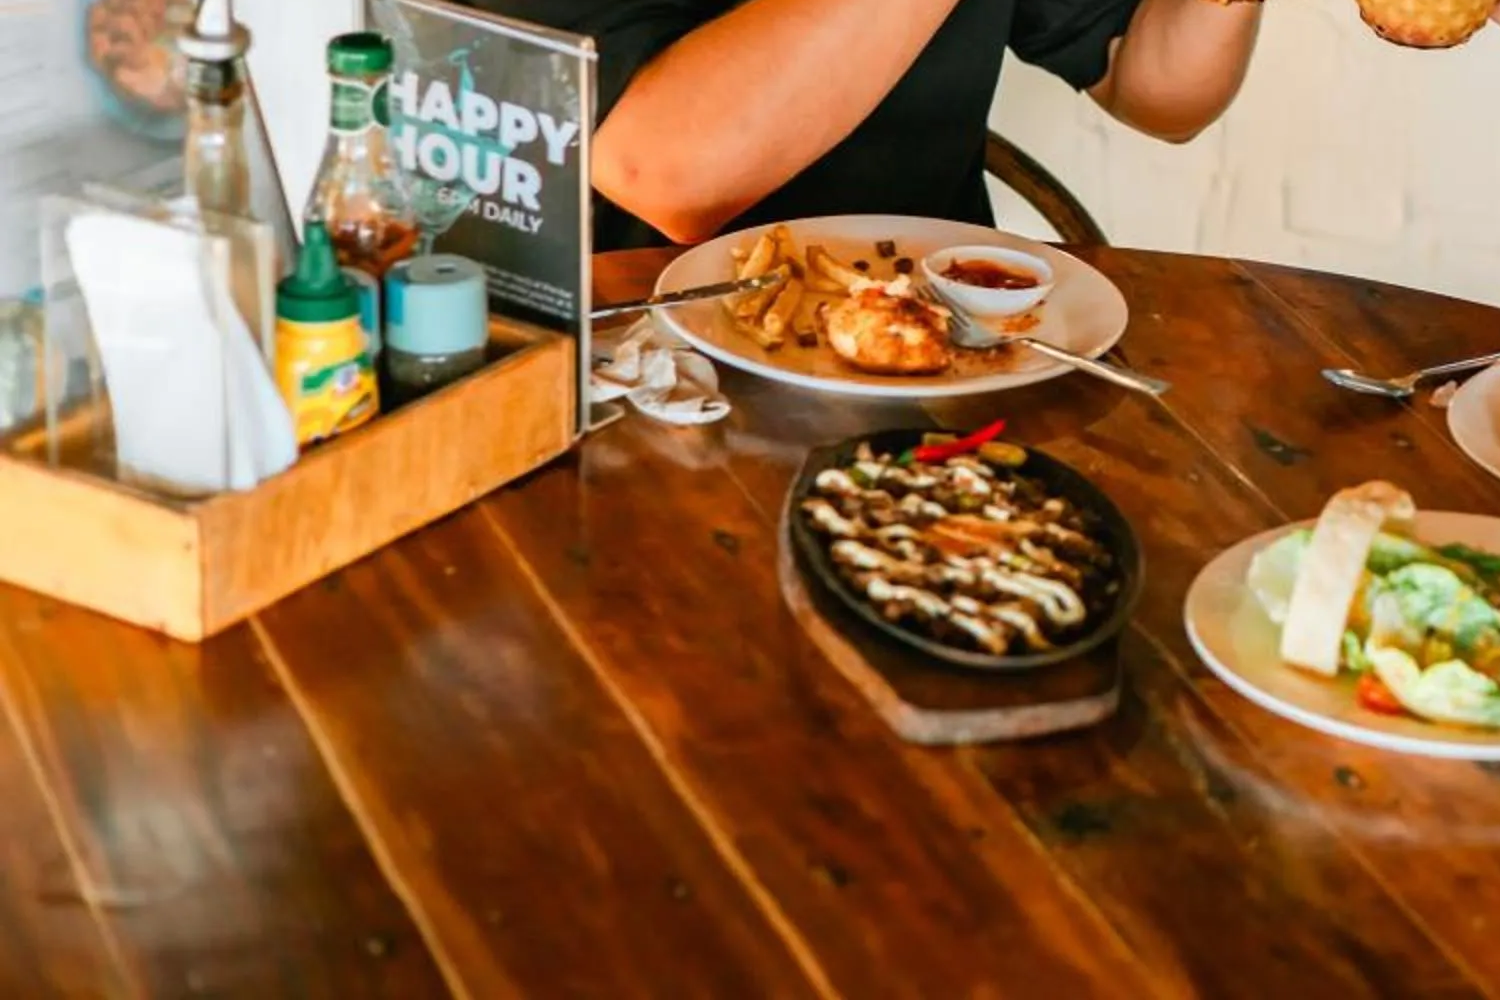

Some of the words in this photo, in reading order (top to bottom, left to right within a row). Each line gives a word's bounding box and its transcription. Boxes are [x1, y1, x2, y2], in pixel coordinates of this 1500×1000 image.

[387, 70, 580, 166] HAPPY
[391, 124, 543, 212] HOUR
[482, 201, 544, 234] DAILY
